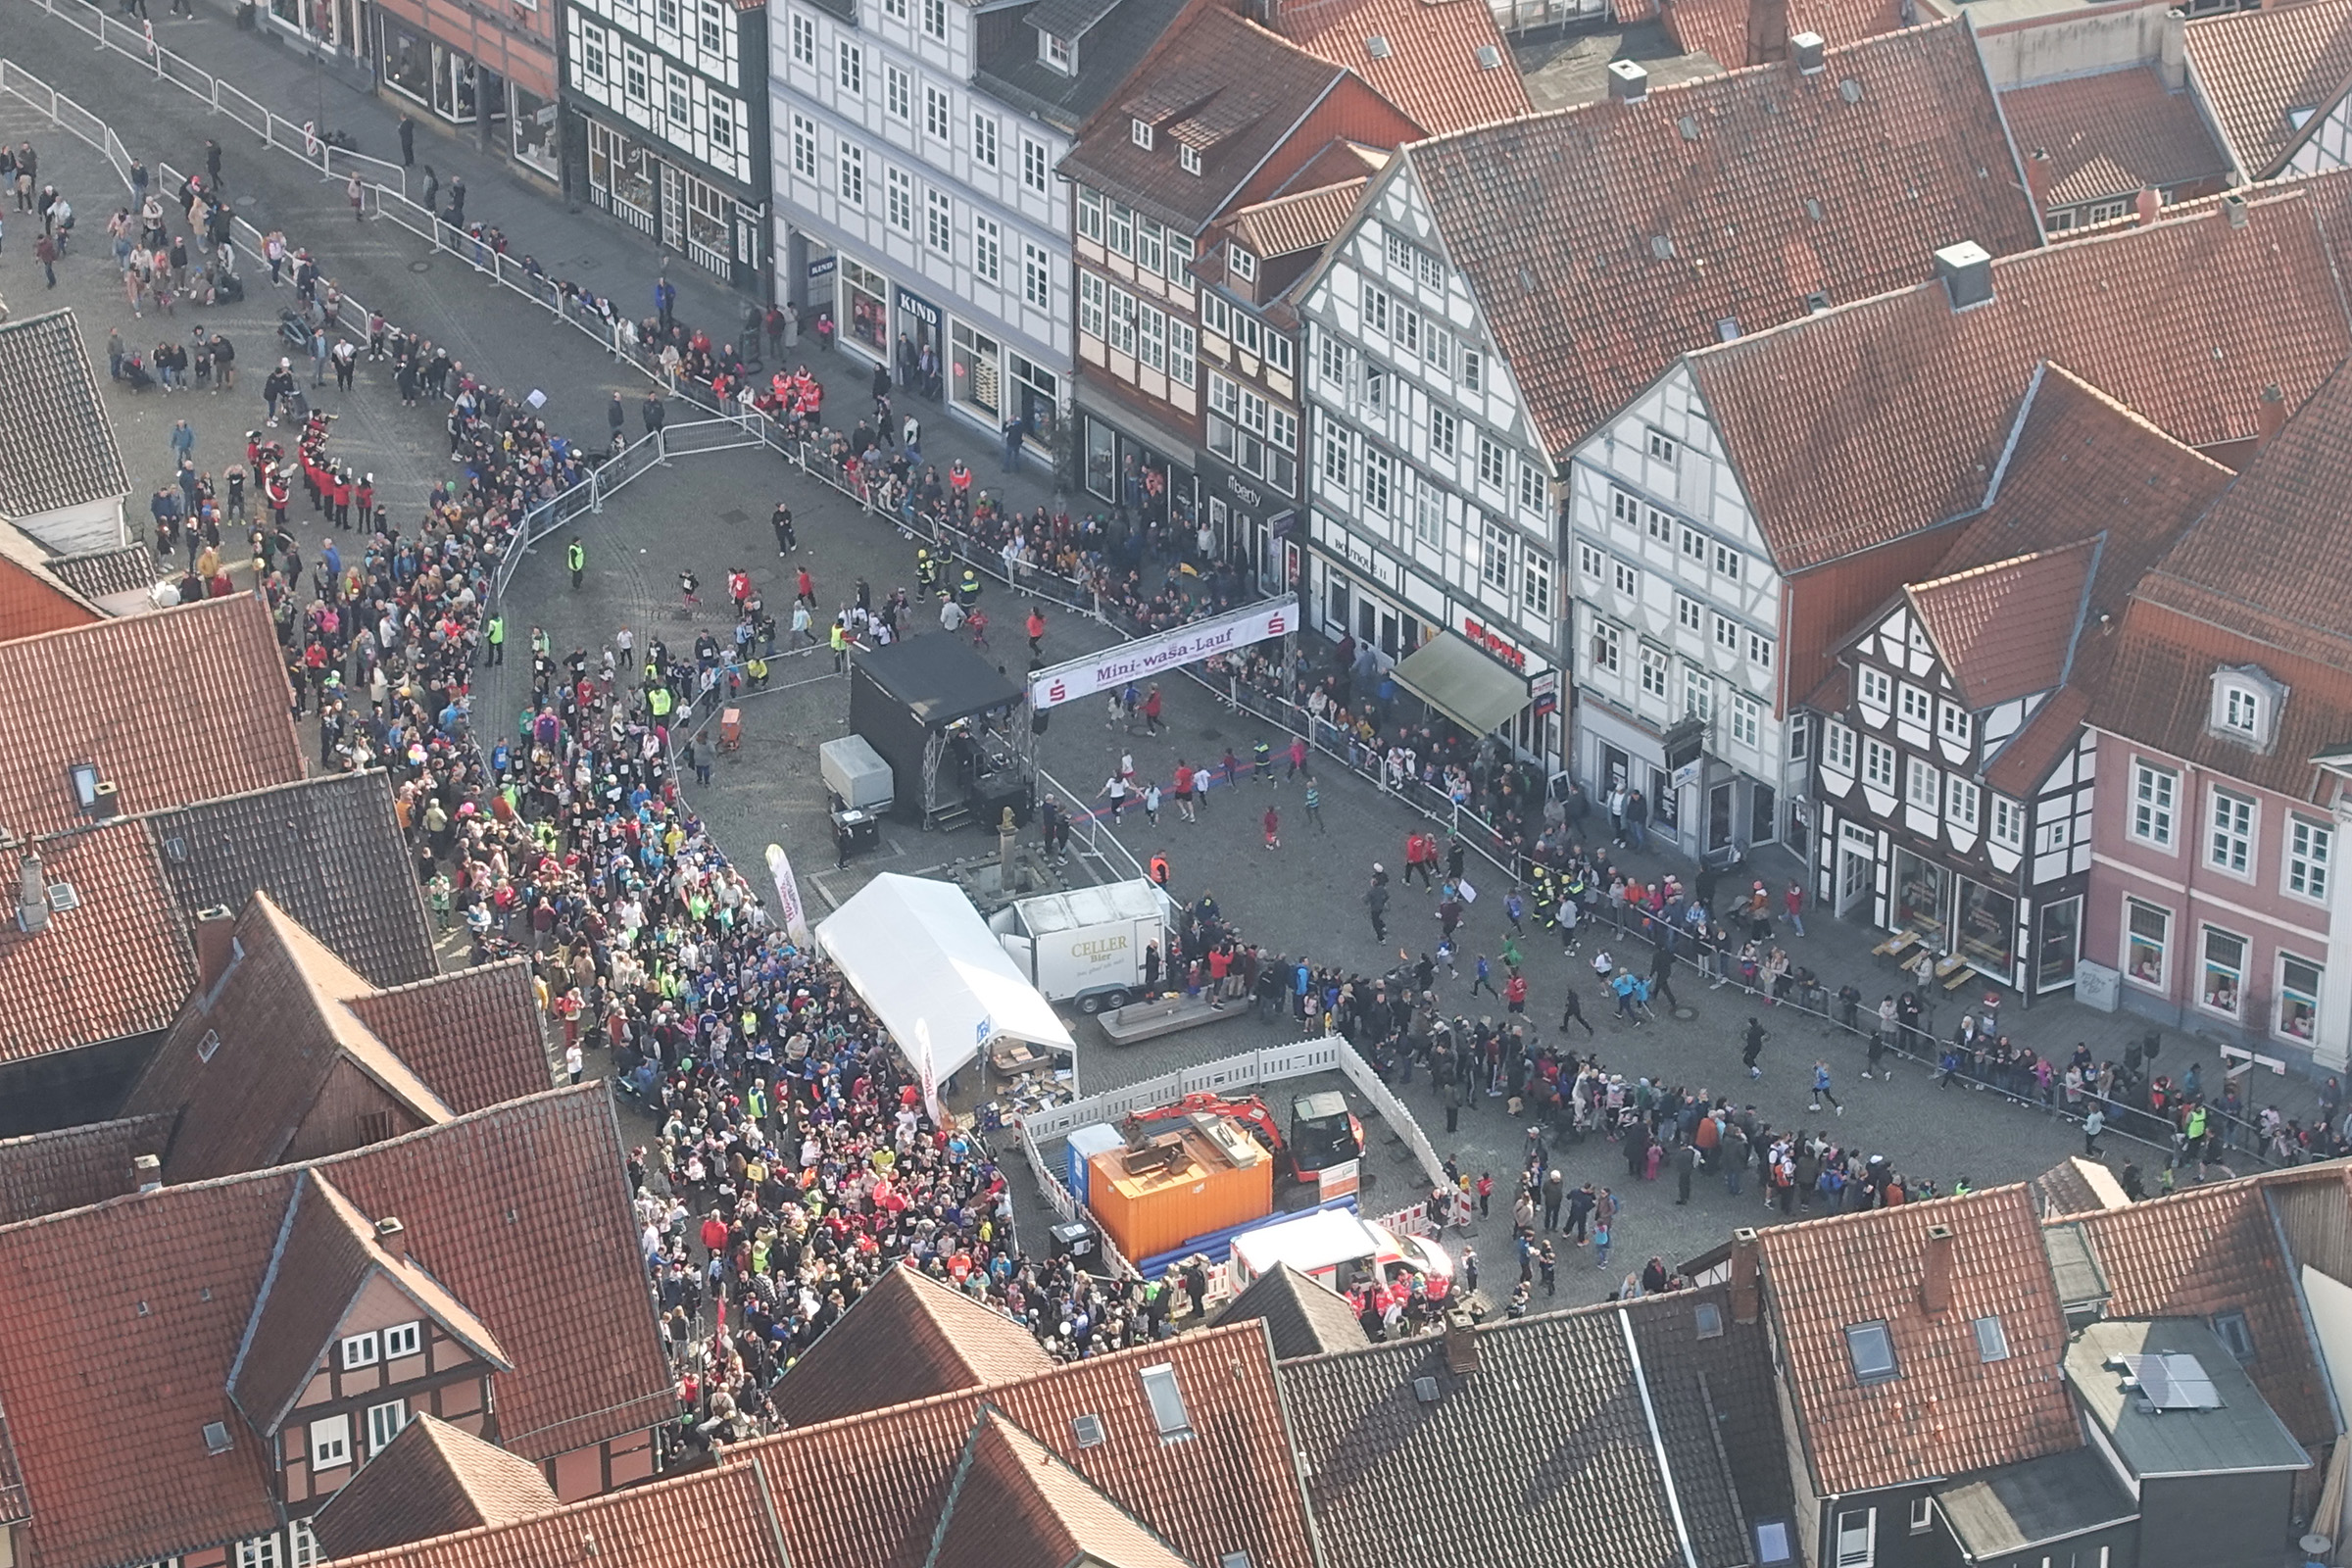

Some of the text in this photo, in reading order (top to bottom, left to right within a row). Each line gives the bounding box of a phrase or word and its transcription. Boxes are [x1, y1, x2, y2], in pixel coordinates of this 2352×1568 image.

[811, 261, 834, 275] KIND
[900, 292, 938, 324] KIND
[1228, 474, 1261, 507] liberty
[1097, 628, 1234, 683] Mini-wasa-Lauf
[1071, 936, 1128, 957] CELLER
[1090, 953, 1112, 963] Bier
